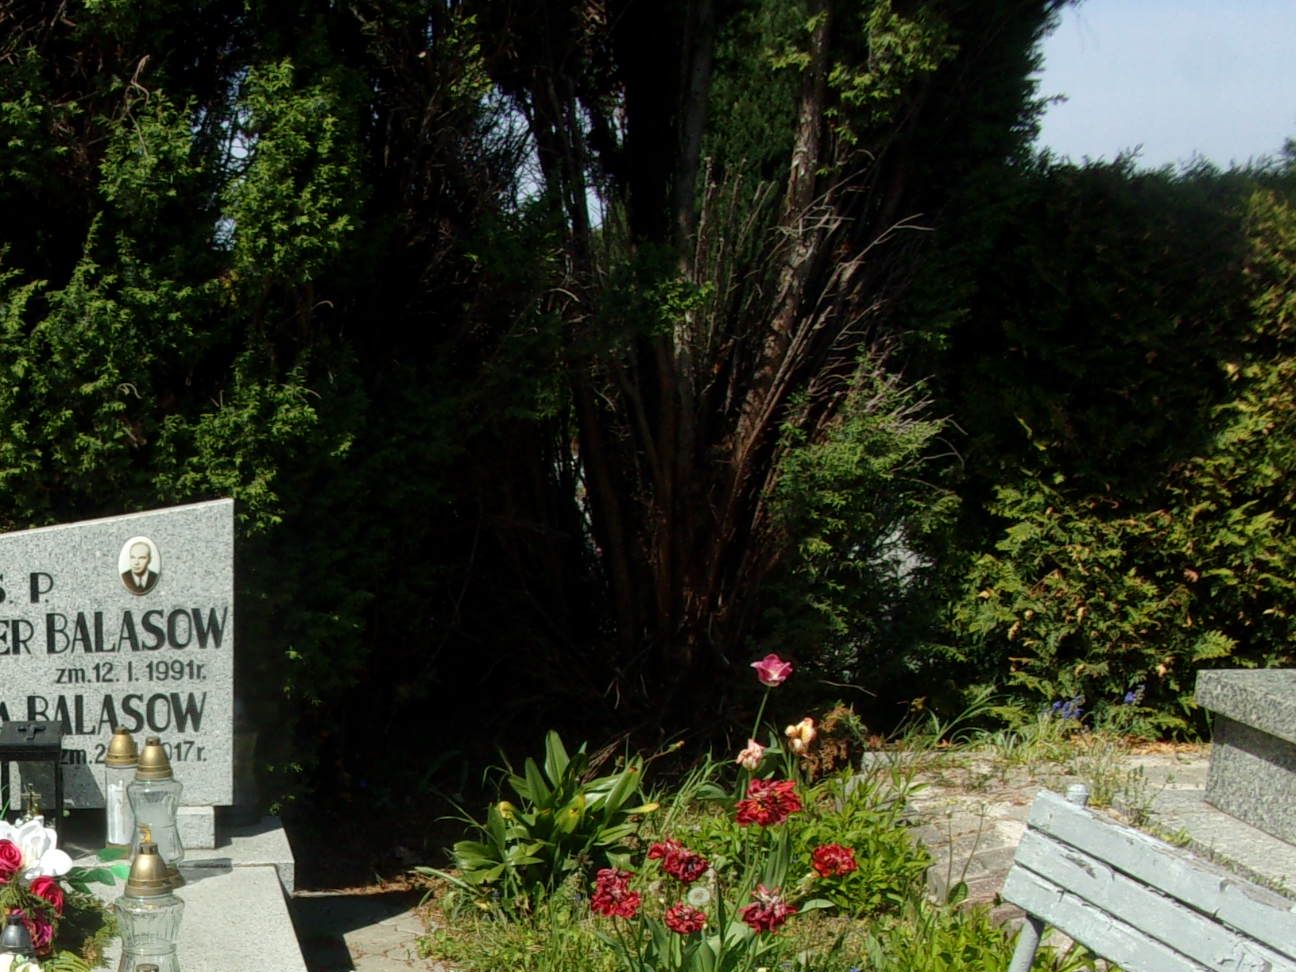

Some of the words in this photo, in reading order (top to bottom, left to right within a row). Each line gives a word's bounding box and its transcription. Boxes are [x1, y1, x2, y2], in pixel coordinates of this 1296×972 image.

[46, 606, 229, 655] BALASOW
[146, 659, 207, 682] 1991r.
[27, 691, 207, 736] BALASOW
